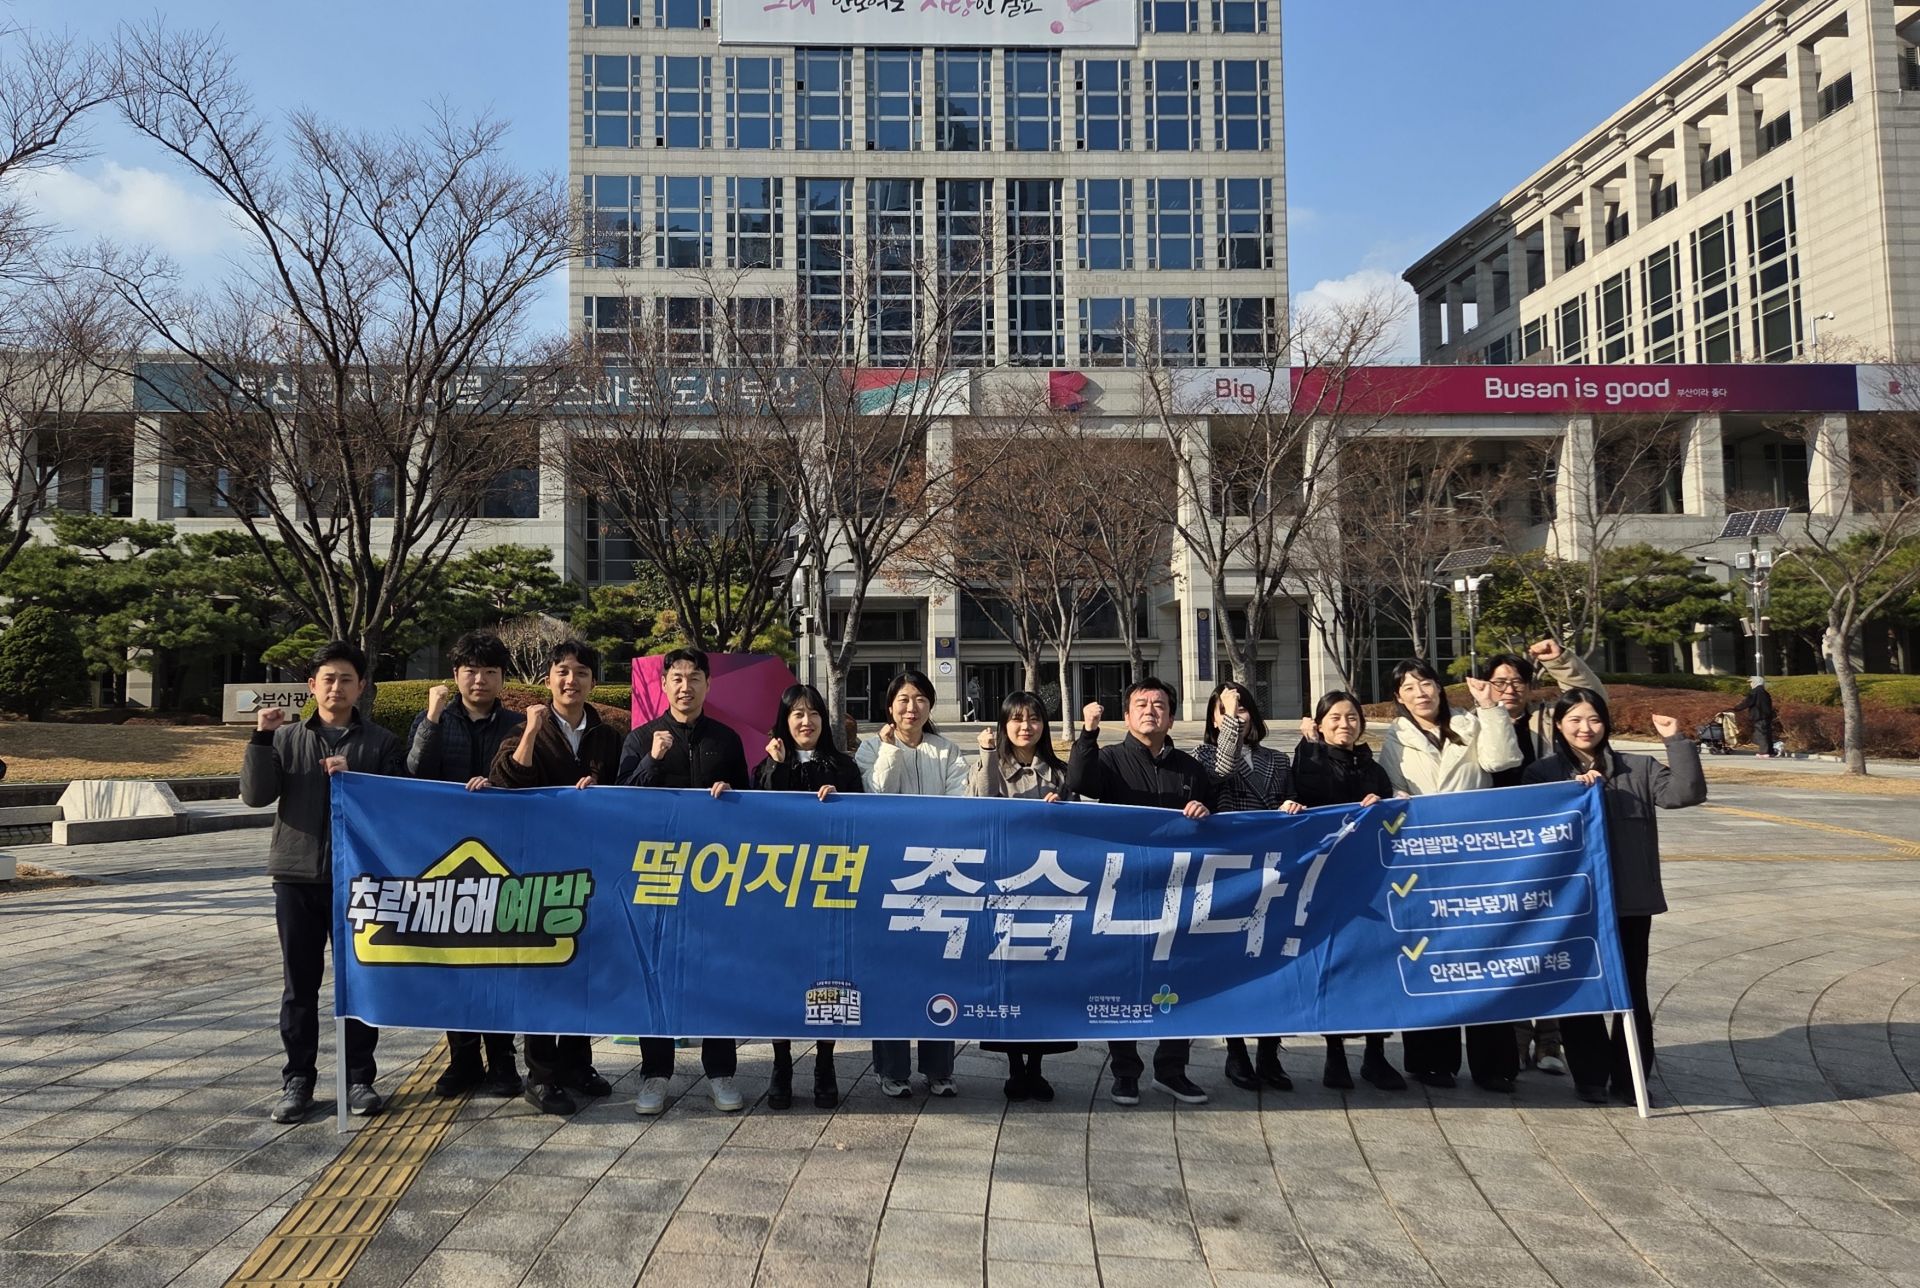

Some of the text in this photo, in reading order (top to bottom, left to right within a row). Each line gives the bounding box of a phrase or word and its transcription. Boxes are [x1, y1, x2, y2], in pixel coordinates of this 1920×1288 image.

[1215, 378, 1255, 404] Big
[1484, 377, 1670, 405] Busan is good
[261, 692, 317, 708] 부산광
[1538, 822, 1574, 845] 설치
[631, 840, 1328, 962] 떨어지면 죽습니다!
[1429, 889, 1554, 918] 개구부덮개 설치
[1543, 950, 1572, 972] 착용
[806, 1004, 860, 1025] 프로젝트
[963, 1003, 1022, 1019] 고용노동부
[1086, 1003, 1154, 1018] 안전보건공단
